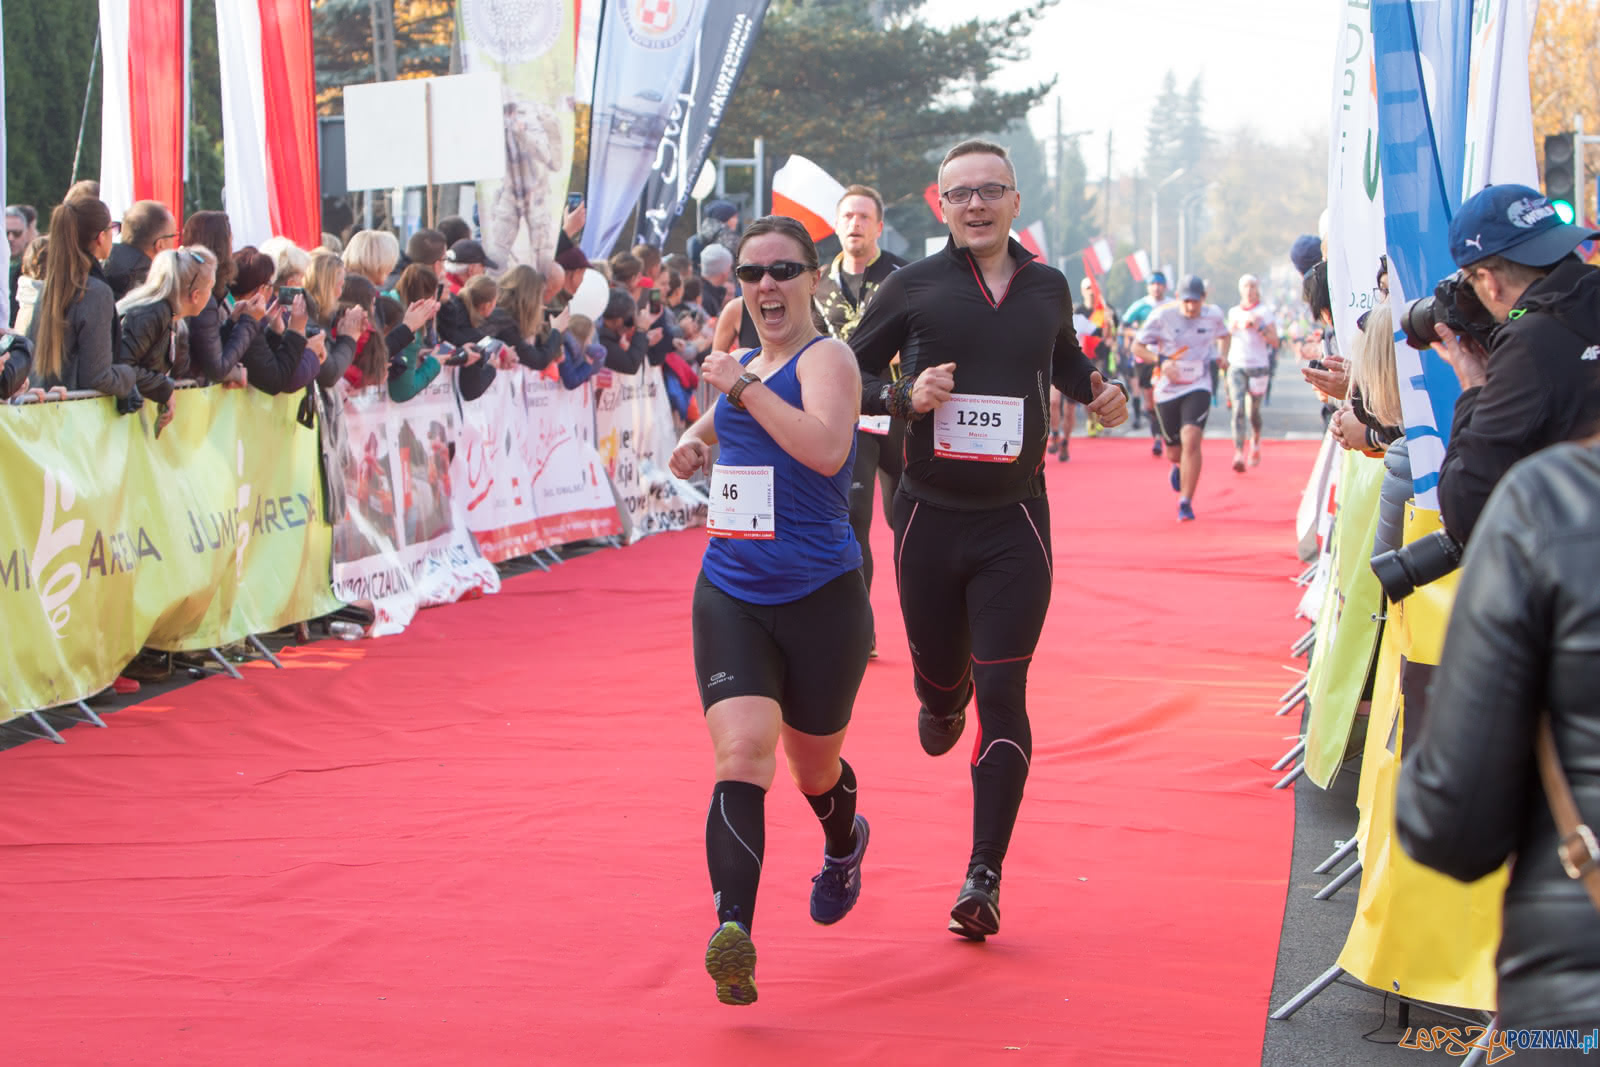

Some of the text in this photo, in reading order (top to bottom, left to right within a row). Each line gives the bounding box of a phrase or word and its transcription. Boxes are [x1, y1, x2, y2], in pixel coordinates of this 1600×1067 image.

[956, 410, 1002, 427] 1295
[722, 484, 738, 500] 46
[86, 527, 162, 579] ARENA
